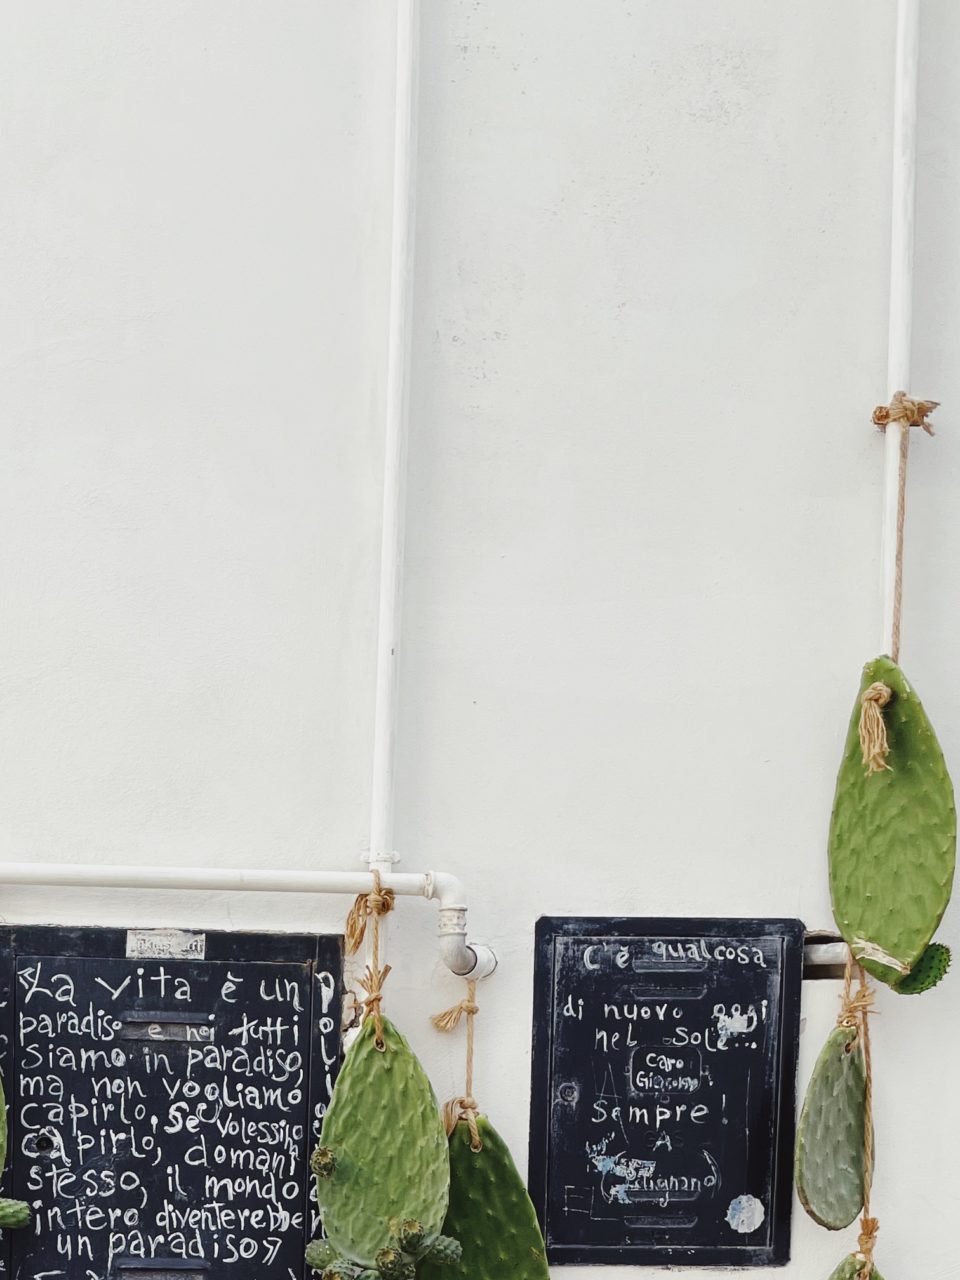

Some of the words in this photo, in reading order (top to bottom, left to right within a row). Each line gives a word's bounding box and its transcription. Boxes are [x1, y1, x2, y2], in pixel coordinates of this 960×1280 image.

[651, 939, 768, 969] qualcosa
[94, 966, 192, 1002] vita
[220, 970, 244, 1003] è
[259, 977, 305, 1012] un
[563, 994, 585, 1020] di
[604, 1003, 684, 1021] nuovo
[19, 1001, 123, 1047] paradiso
[147, 1023, 166, 1040] e
[185, 1013, 216, 1043] noi
[227, 1012, 300, 1047] tutti
[594, 1022, 639, 1053] nel
[142, 1046, 175, 1076] in
[20, 1073, 65, 1102] ma
[91, 1075, 148, 1099] non
[161, 1074, 303, 1124] vogliamo
[184, 1134, 301, 1177] domani
[166, 1163, 189, 1196] il
[204, 1171, 301, 1206] mondo
[31, 1198, 141, 1236] intero
[155, 1199, 304, 1234] diventerebbe
[56, 1233, 95, 1261] un
